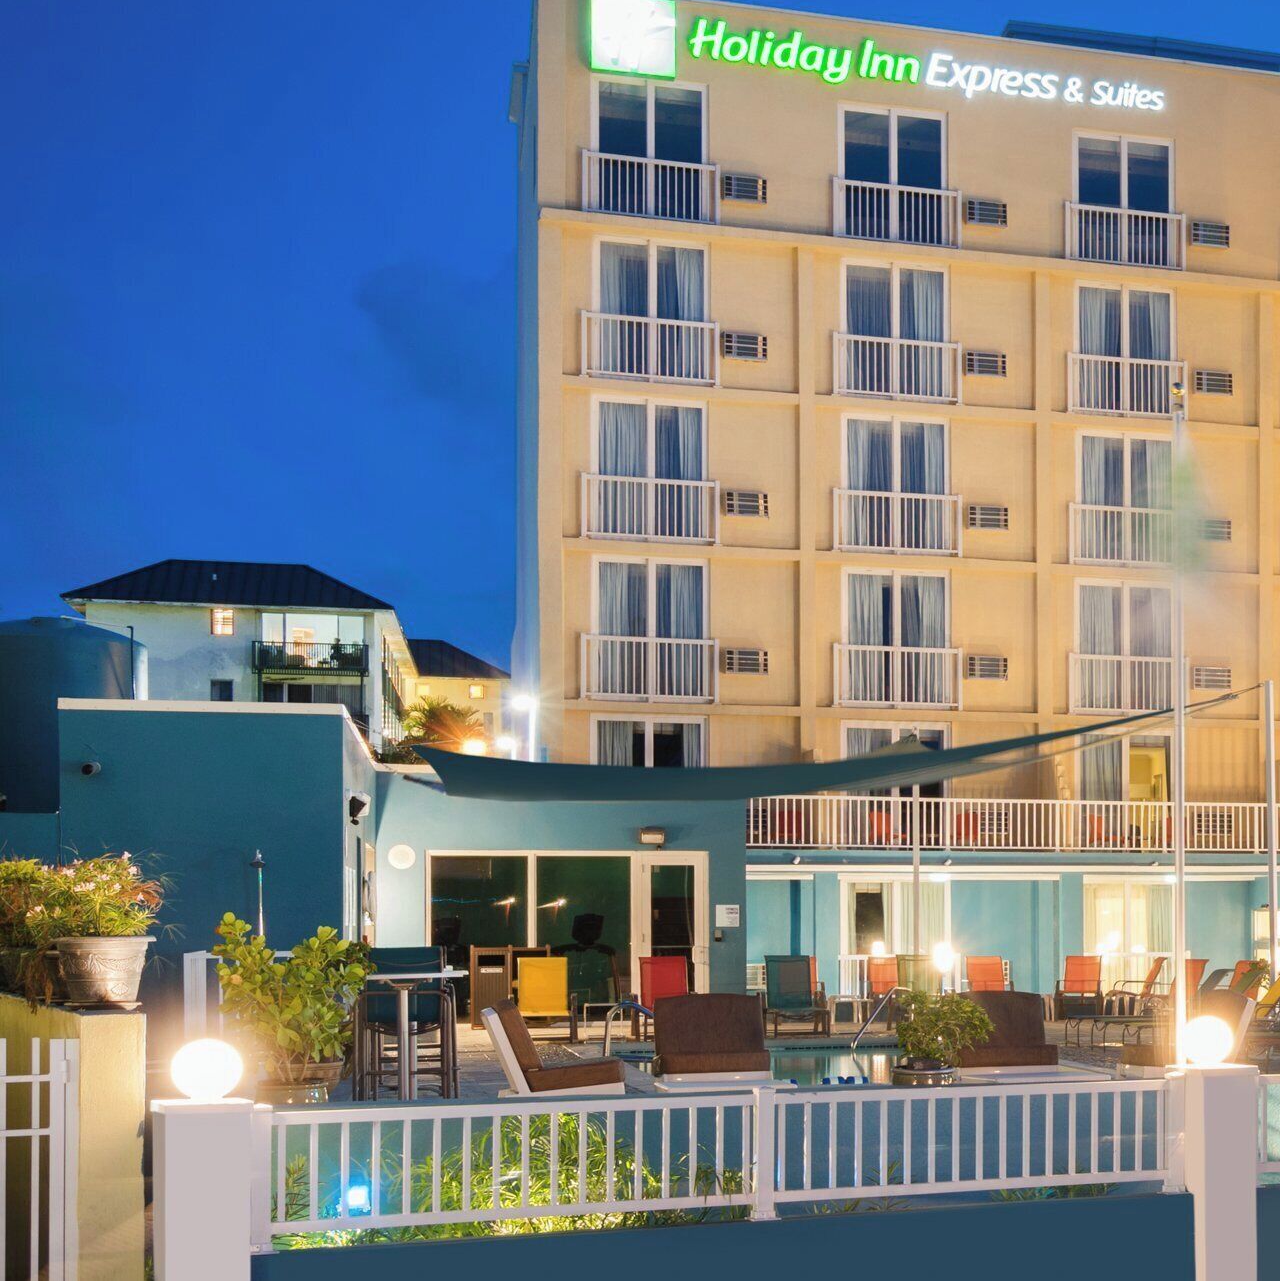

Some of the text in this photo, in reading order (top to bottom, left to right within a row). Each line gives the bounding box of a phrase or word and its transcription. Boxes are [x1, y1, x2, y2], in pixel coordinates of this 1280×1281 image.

[688, 17, 1165, 111] Holiday Inn Express & Suites
